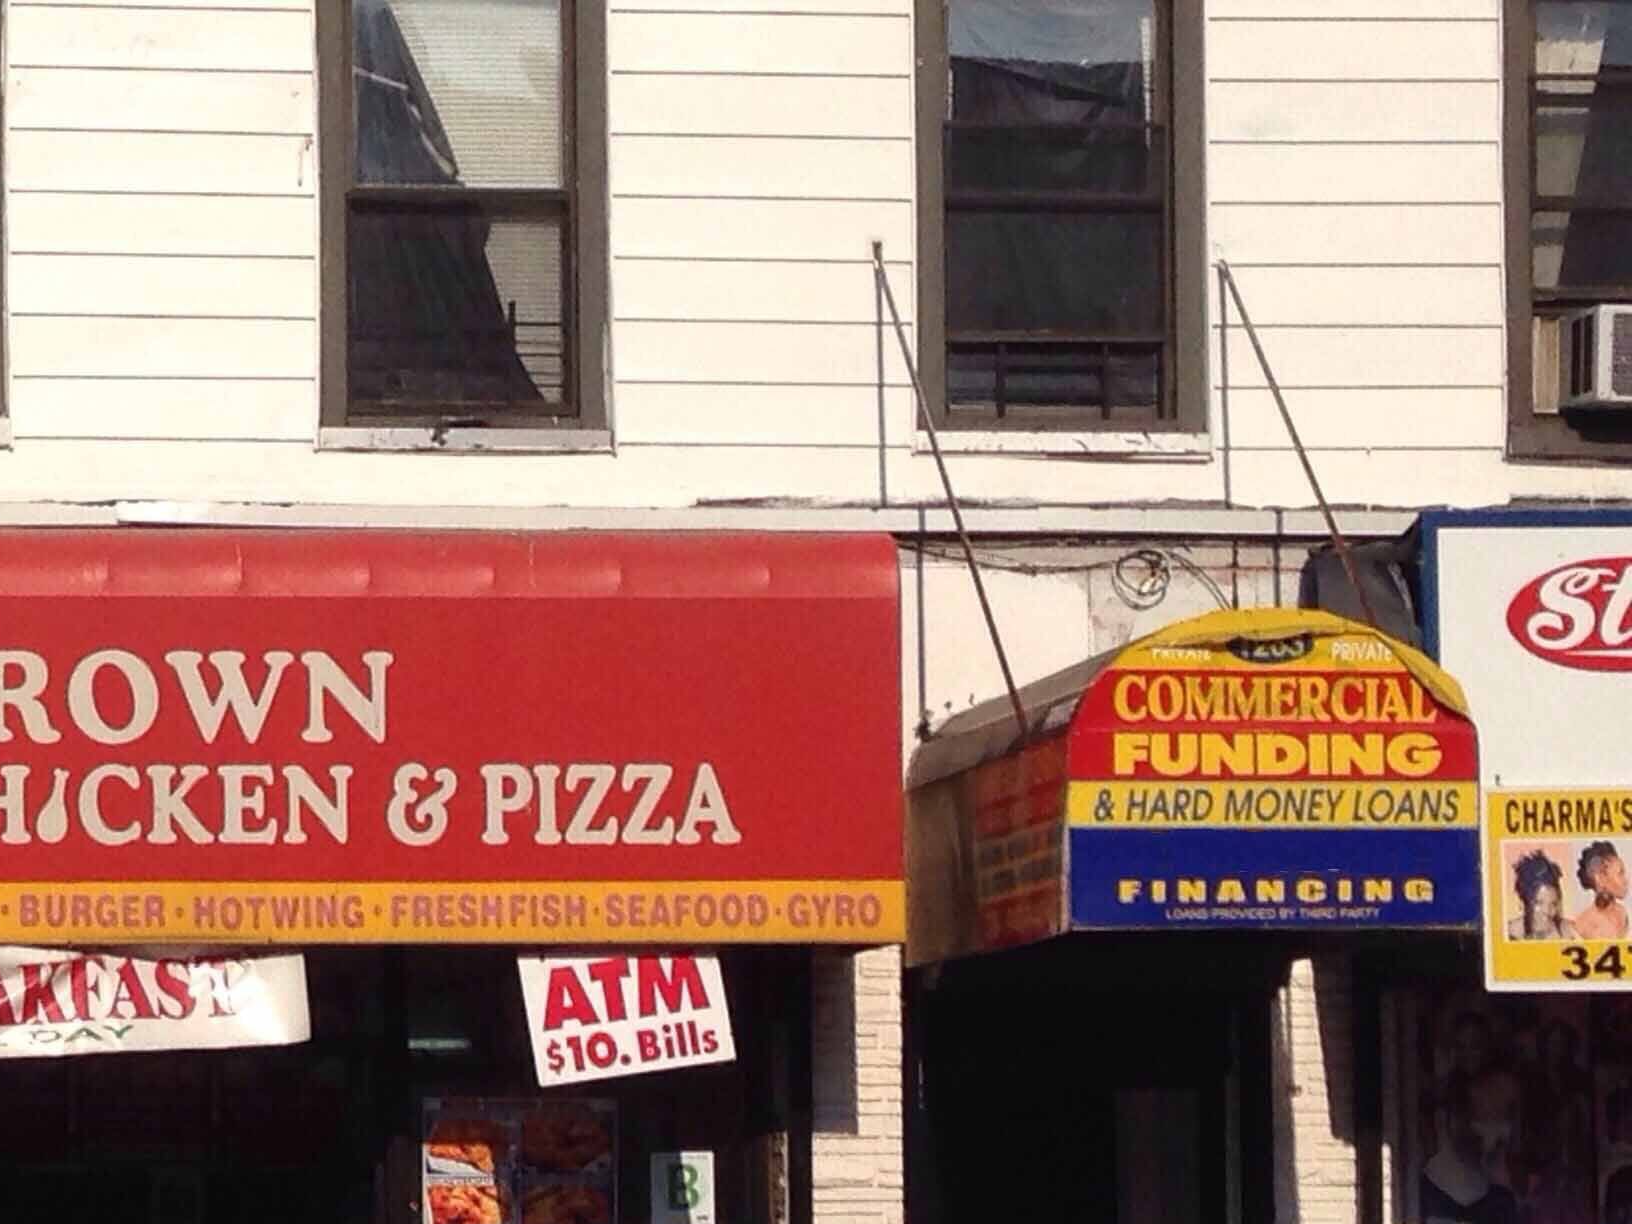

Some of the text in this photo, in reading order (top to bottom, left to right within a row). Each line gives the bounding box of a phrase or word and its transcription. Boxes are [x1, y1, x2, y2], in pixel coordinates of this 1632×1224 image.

[1330, 640, 1393, 662] PRIVATE
[1113, 674, 1438, 724] COMMERCIAL
[1113, 731, 1443, 777] FUNDING
[386, 763, 458, 846] &
[480, 762, 742, 845] PIZZA
[1093, 788, 1459, 823] & HARD MONEY LOANS
[1117, 878, 1435, 904] FINANCING
[18, 894, 166, 928] BURGER
[604, 894, 769, 928] SEAFOOD
[786, 894, 883, 928] GYRO
[1279, 907, 1297, 920] BY
[543, 948, 711, 1032] ATM
[29, 1024, 135, 1045] DAY
[546, 1020, 720, 1076] $10. Bills
